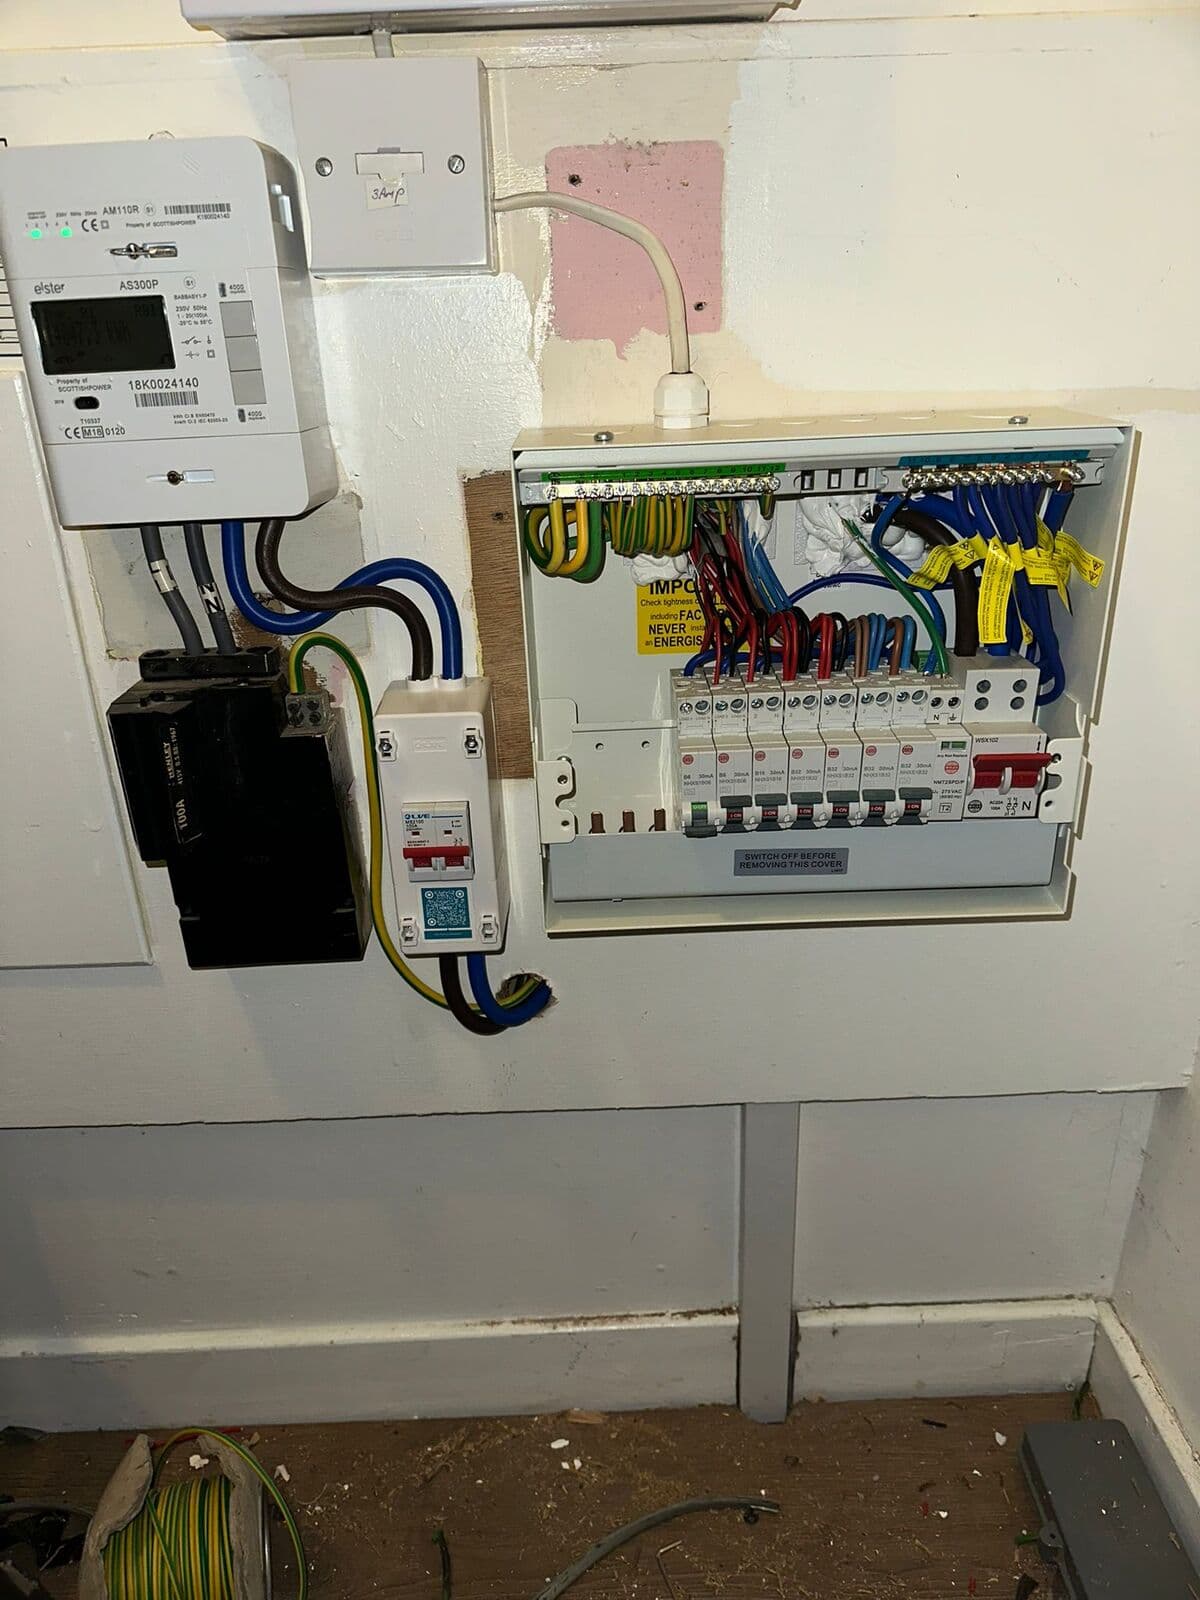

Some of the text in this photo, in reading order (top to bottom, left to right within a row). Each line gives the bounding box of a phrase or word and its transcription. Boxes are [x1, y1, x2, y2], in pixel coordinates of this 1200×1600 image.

[102, 205, 140, 215] AM110R
[34, 282, 65, 294] elster
[120, 280, 159, 290] AS300P
[58, 384, 112, 392] SCOTTISHPOWER
[128, 377, 199, 390] 18K0024140
[105, 426, 126, 436] 0120
[664, 598, 693, 607] tightness
[649, 623, 686, 634] NEVER
[1022, 801, 1031, 810] N
